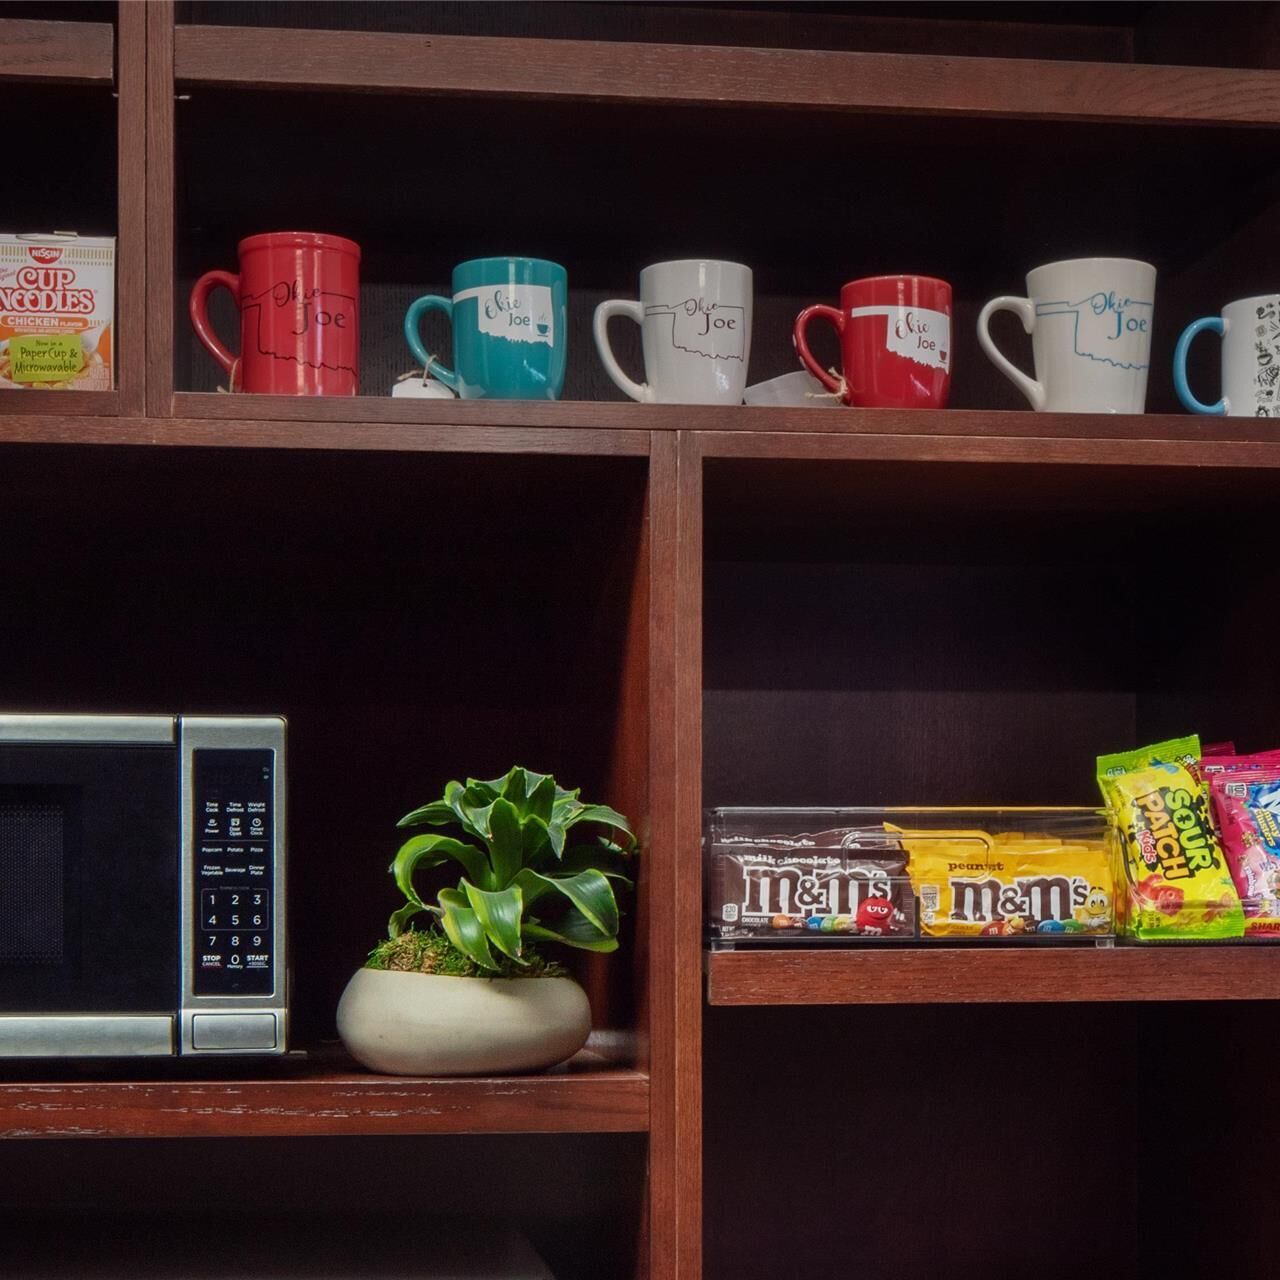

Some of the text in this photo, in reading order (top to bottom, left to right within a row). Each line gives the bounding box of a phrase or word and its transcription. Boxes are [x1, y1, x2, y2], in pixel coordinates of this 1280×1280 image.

[32, 248, 60, 259] NISSIN
[17, 266, 75, 290] CUP
[7, 317, 59, 326] CHICKEN
[292, 303, 345, 335] Joe
[509, 313, 530, 326] Joe
[698, 313, 736, 336] Joe
[1107, 311, 1147, 340] Joe
[917, 336, 935, 350] Joe
[20, 347, 77, 360] Paper Cup &
[14, 361, 77, 374] Microwavable
[1165, 788, 1212, 869] SOUR
[1135, 790, 1191, 880] PATCH
[1136, 830, 1156, 864] Kids
[743, 854, 841, 866] milk chocolate
[210, 895, 215, 904] 1
[232, 895, 239, 905] 2
[254, 895, 261, 905] 3
[949, 876, 1089, 923] m&m's
[209, 915, 216, 925] 4
[232, 915, 239, 925] 5
[253, 915, 261, 925] 6
[209, 936, 216, 946] 7
[232, 936, 239, 946] 8
[253, 936, 261, 946] 9
[231, 955, 239, 964] 0
